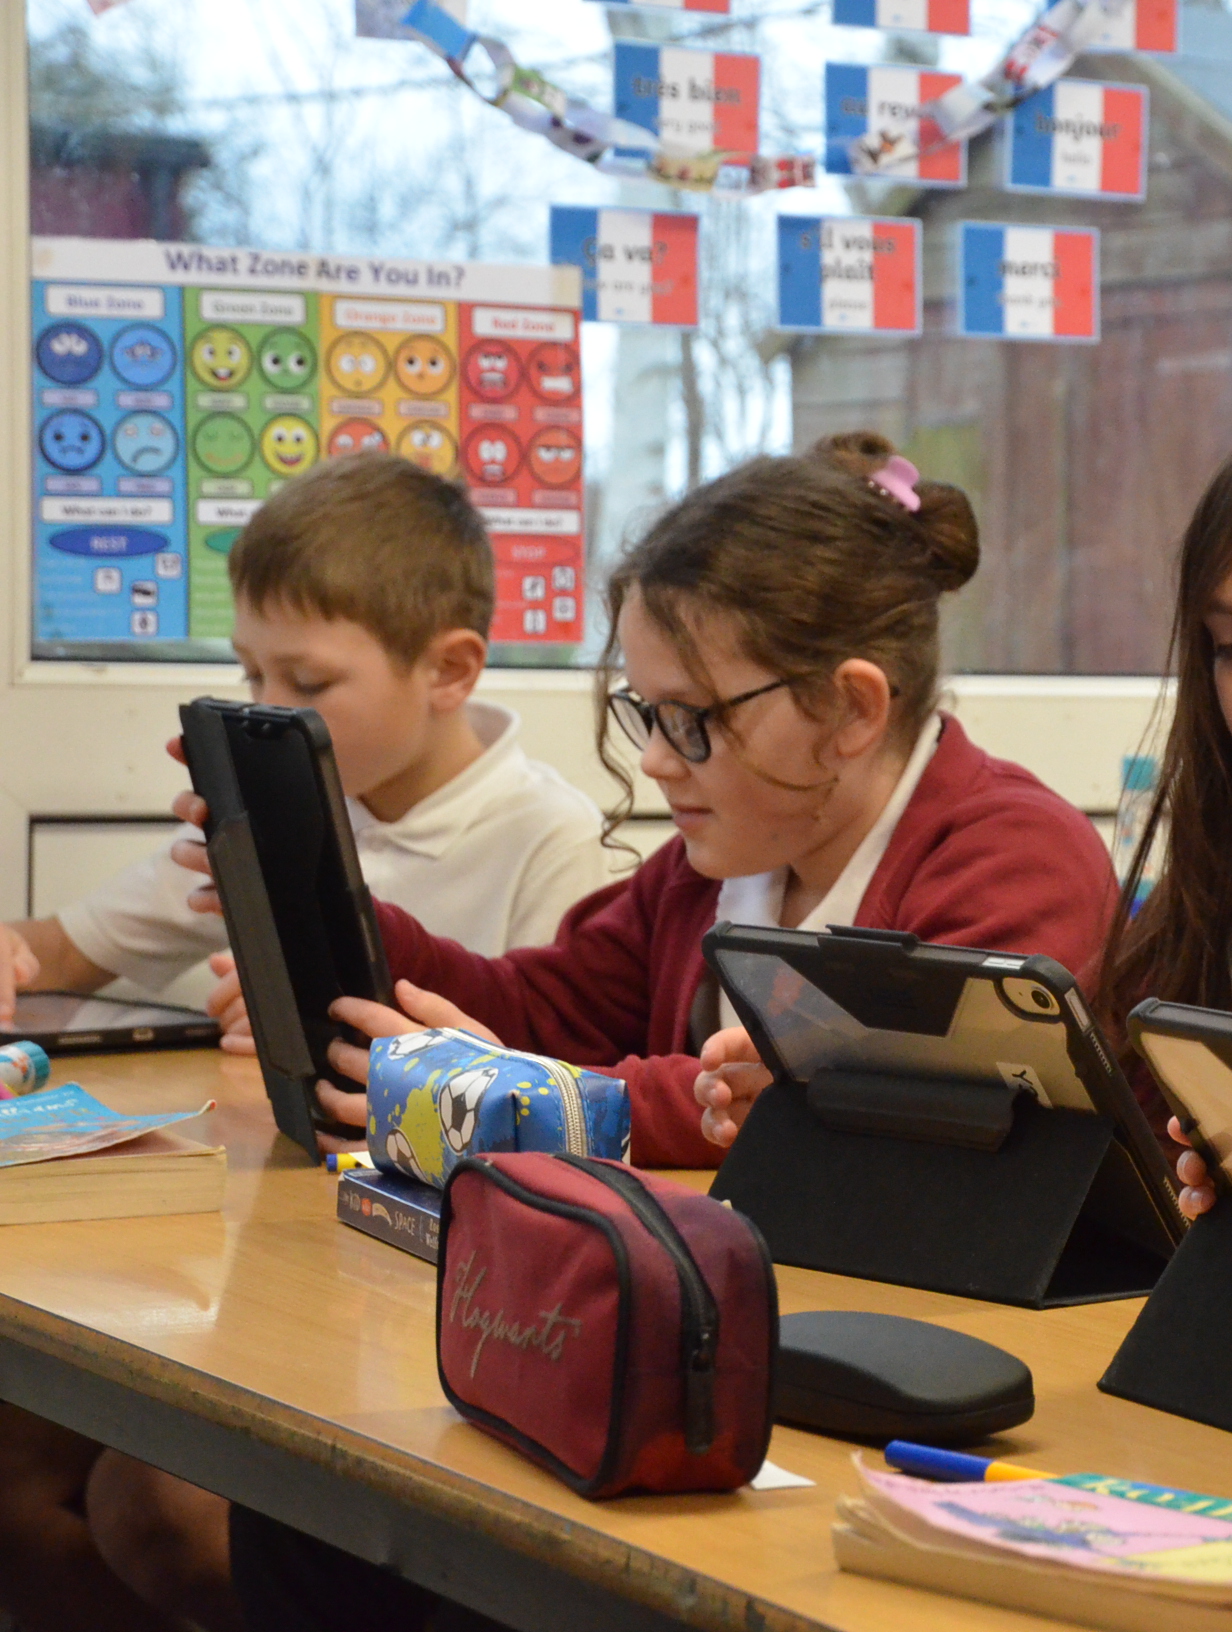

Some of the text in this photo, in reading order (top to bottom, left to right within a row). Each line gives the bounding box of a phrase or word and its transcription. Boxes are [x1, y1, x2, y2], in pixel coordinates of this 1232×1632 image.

[1035, 109, 1121, 143] bonjour
[163, 248, 466, 288] What Zone Are You In?
[996, 254, 1062, 278] merci
[66, 293, 144, 310] Blue Zone
[260, 301, 293, 317] Zone
[343, 308, 437, 327] Orange Zone
[491, 316, 556, 333] Red Zone
[394, 1210, 416, 1236] SPACE
[450, 1250, 582, 1379] Hogwarts
